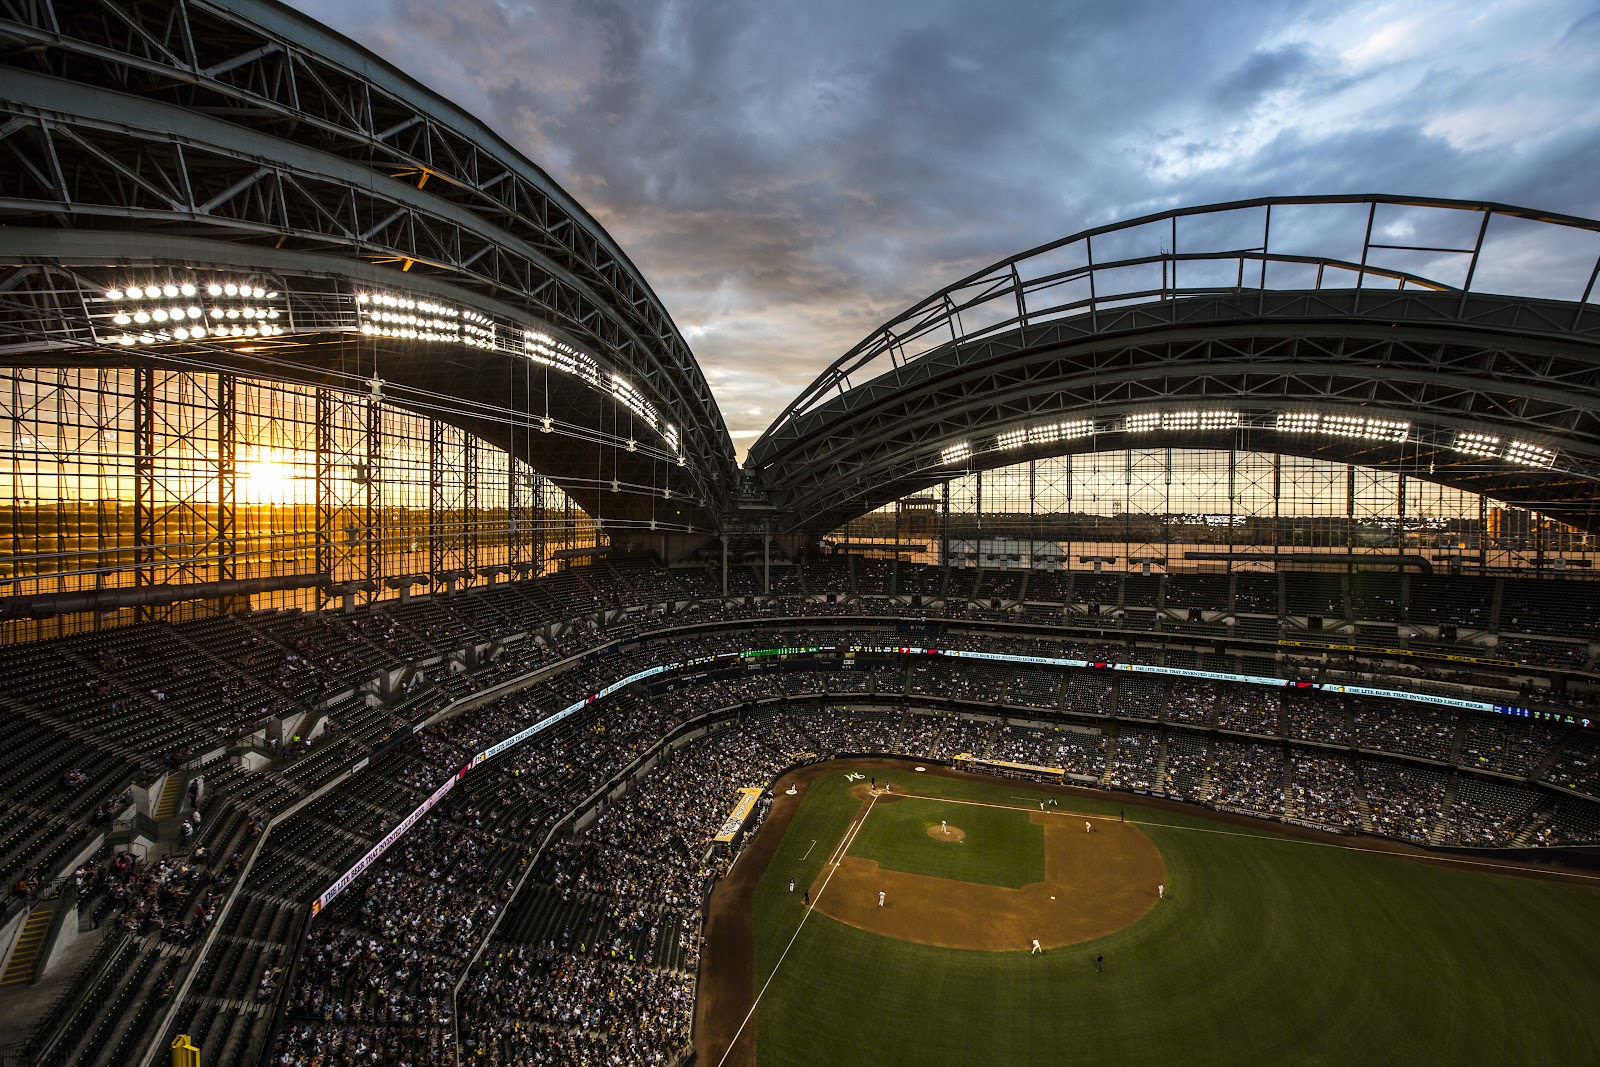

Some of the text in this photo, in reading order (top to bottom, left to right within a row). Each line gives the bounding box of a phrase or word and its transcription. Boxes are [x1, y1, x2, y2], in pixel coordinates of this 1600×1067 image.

[1409, 694, 1442, 703] INVENTED
[1444, 698, 1464, 707] LIGHT
[1234, 808, 1254, 816] Warner
[1254, 812, 1271, 820] Cable
[1301, 822, 1322, 830] Warner
[1323, 826, 1341, 834] Cable
[324, 807, 425, 902] THE LITE BEER THAT INVENTED LIGHT BEER
